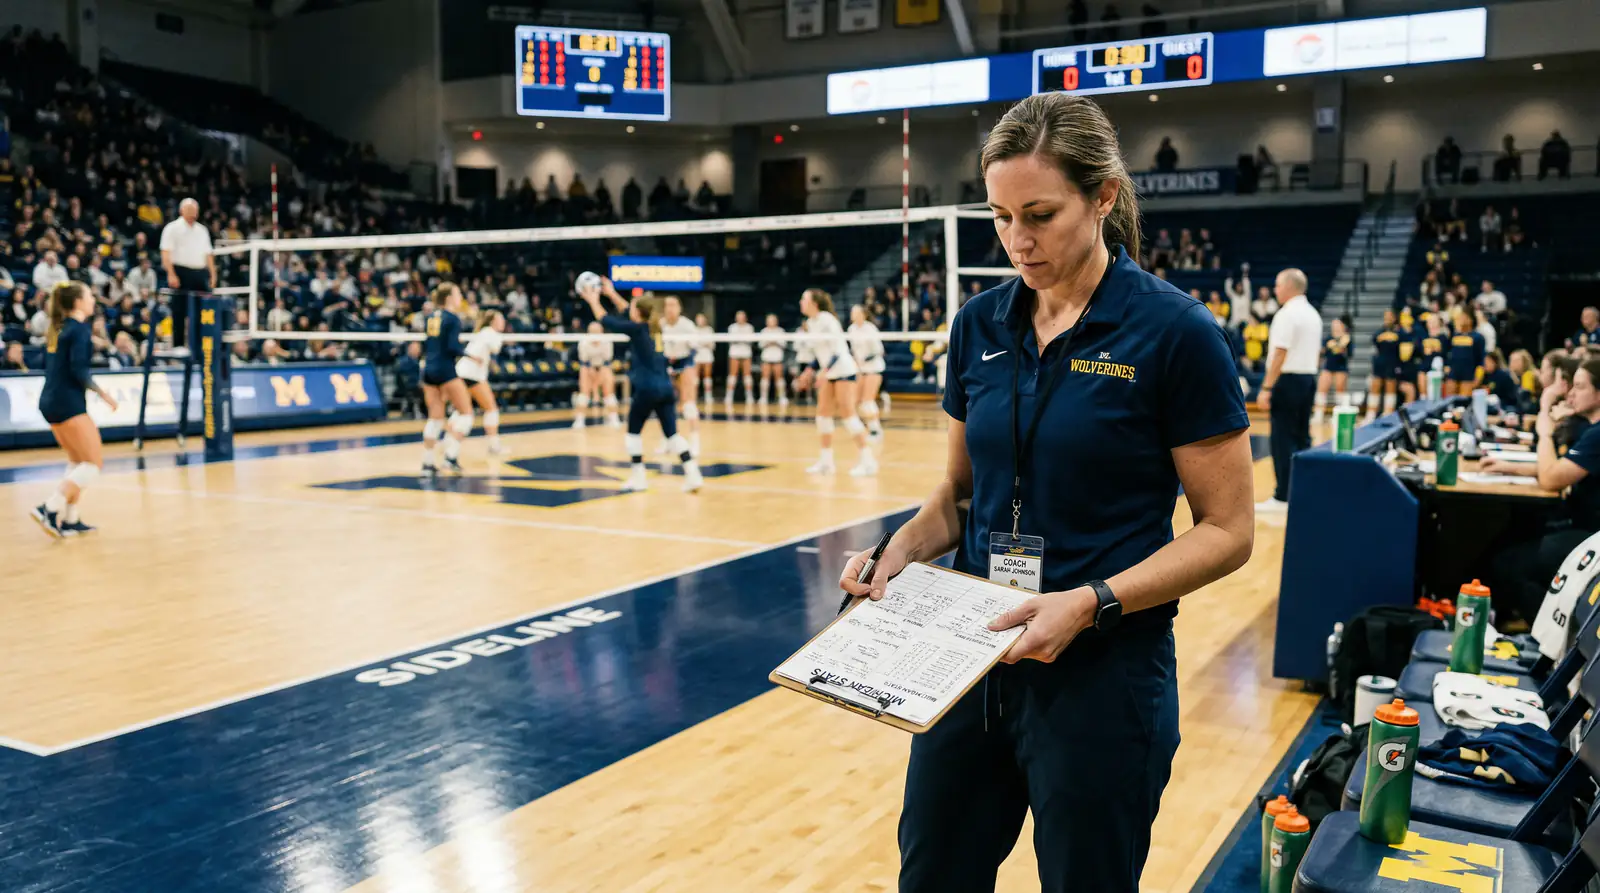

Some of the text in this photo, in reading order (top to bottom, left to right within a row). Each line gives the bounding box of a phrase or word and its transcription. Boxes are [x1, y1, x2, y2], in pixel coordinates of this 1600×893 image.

[1063, 67, 1079, 90] 0
[1187, 55, 1203, 80] 0
[1070, 358, 1136, 380] WOLVERINES
[270, 373, 368, 407] M M
[1003, 558, 1027, 568] COACH
[1011, 568, 1036, 576] JOHNSON
[355, 606, 623, 687] SIDELINE
[810, 668, 849, 686] STATS
[1378, 743, 1406, 772] G
